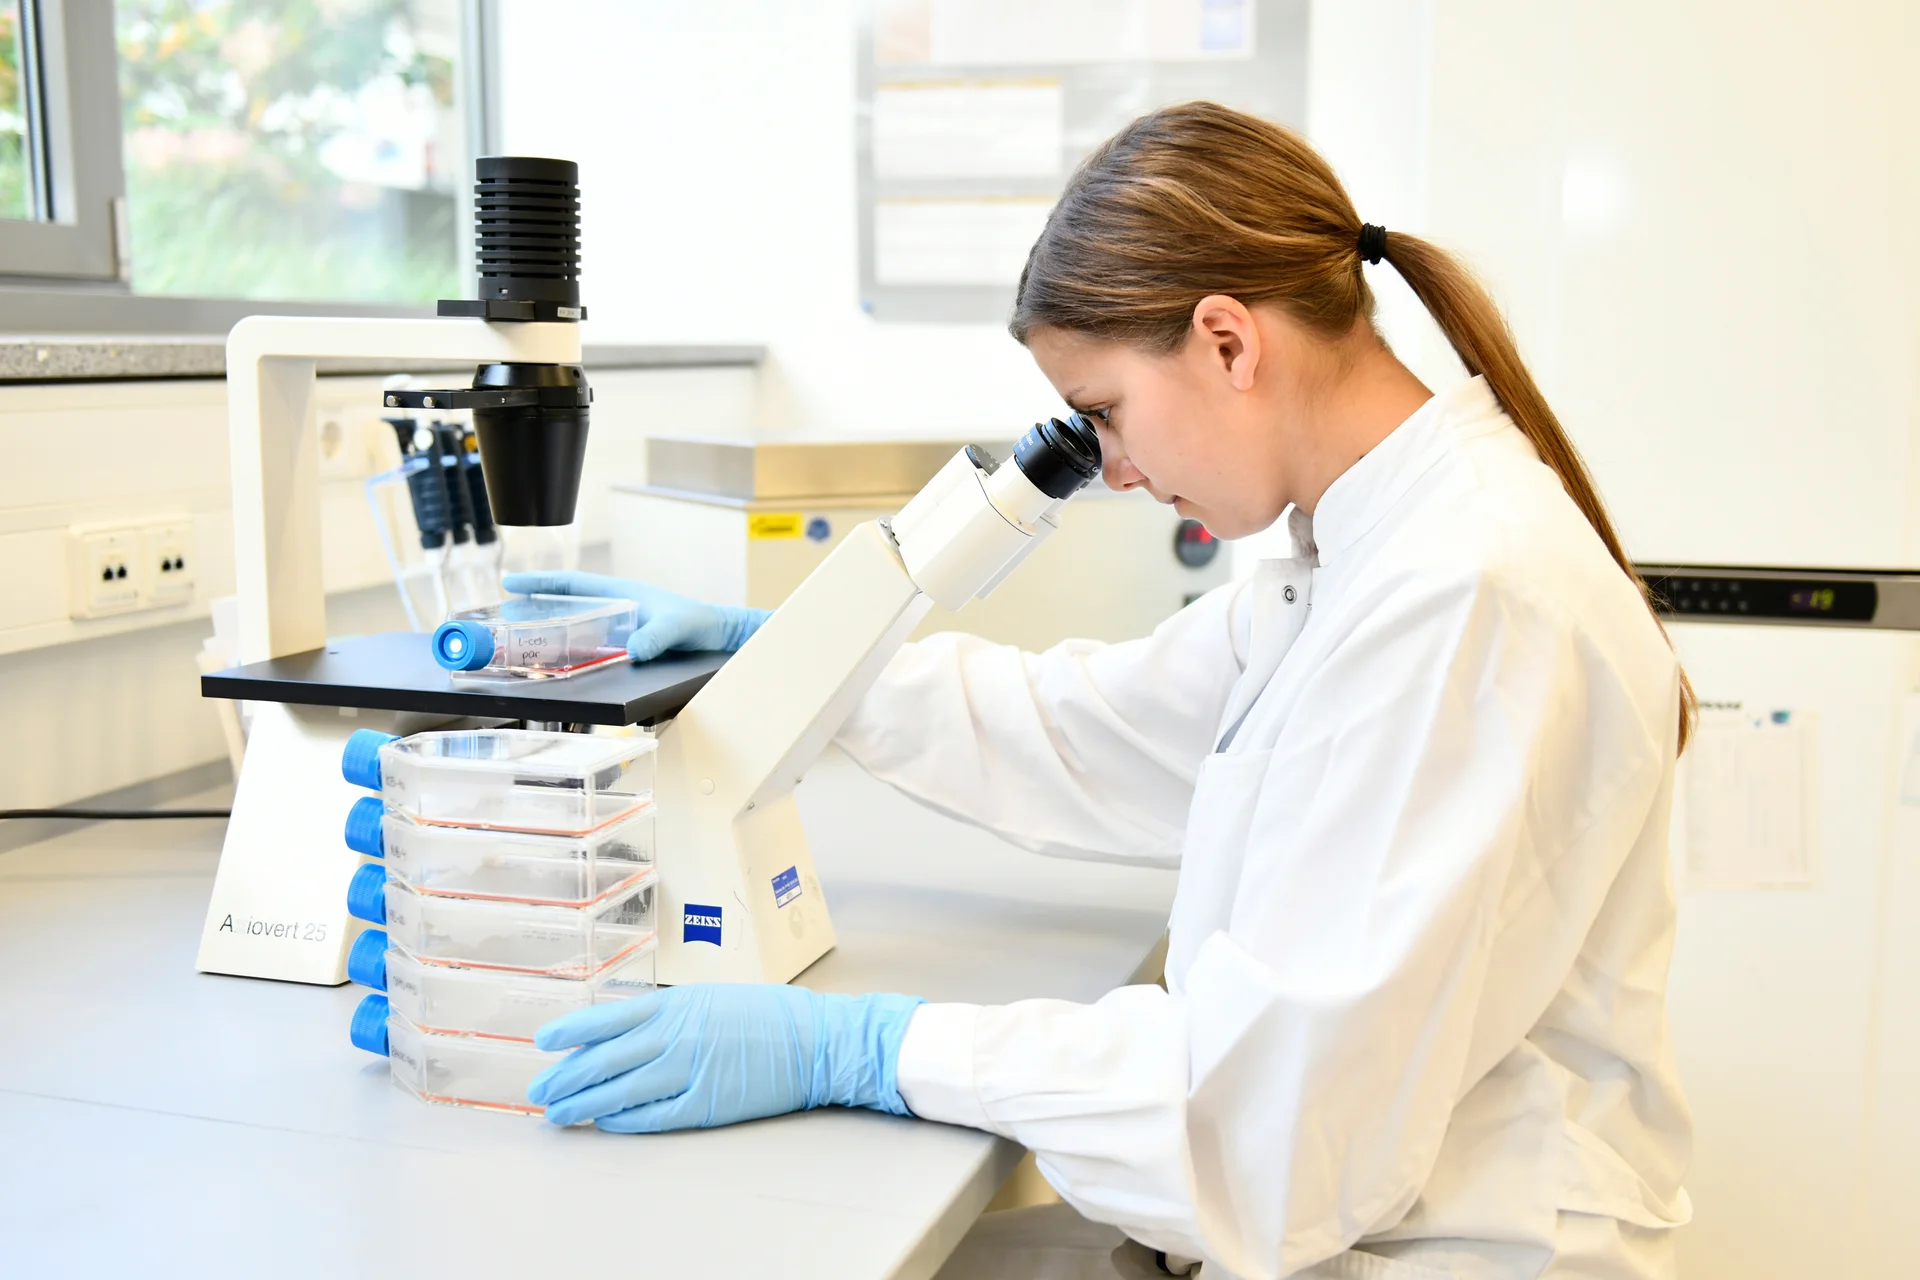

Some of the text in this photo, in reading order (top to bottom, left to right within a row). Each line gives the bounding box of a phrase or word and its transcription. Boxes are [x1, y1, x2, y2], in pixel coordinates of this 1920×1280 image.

[219, 913, 328, 942] Aiovert 25
[684, 914, 722, 928] ZEISS
